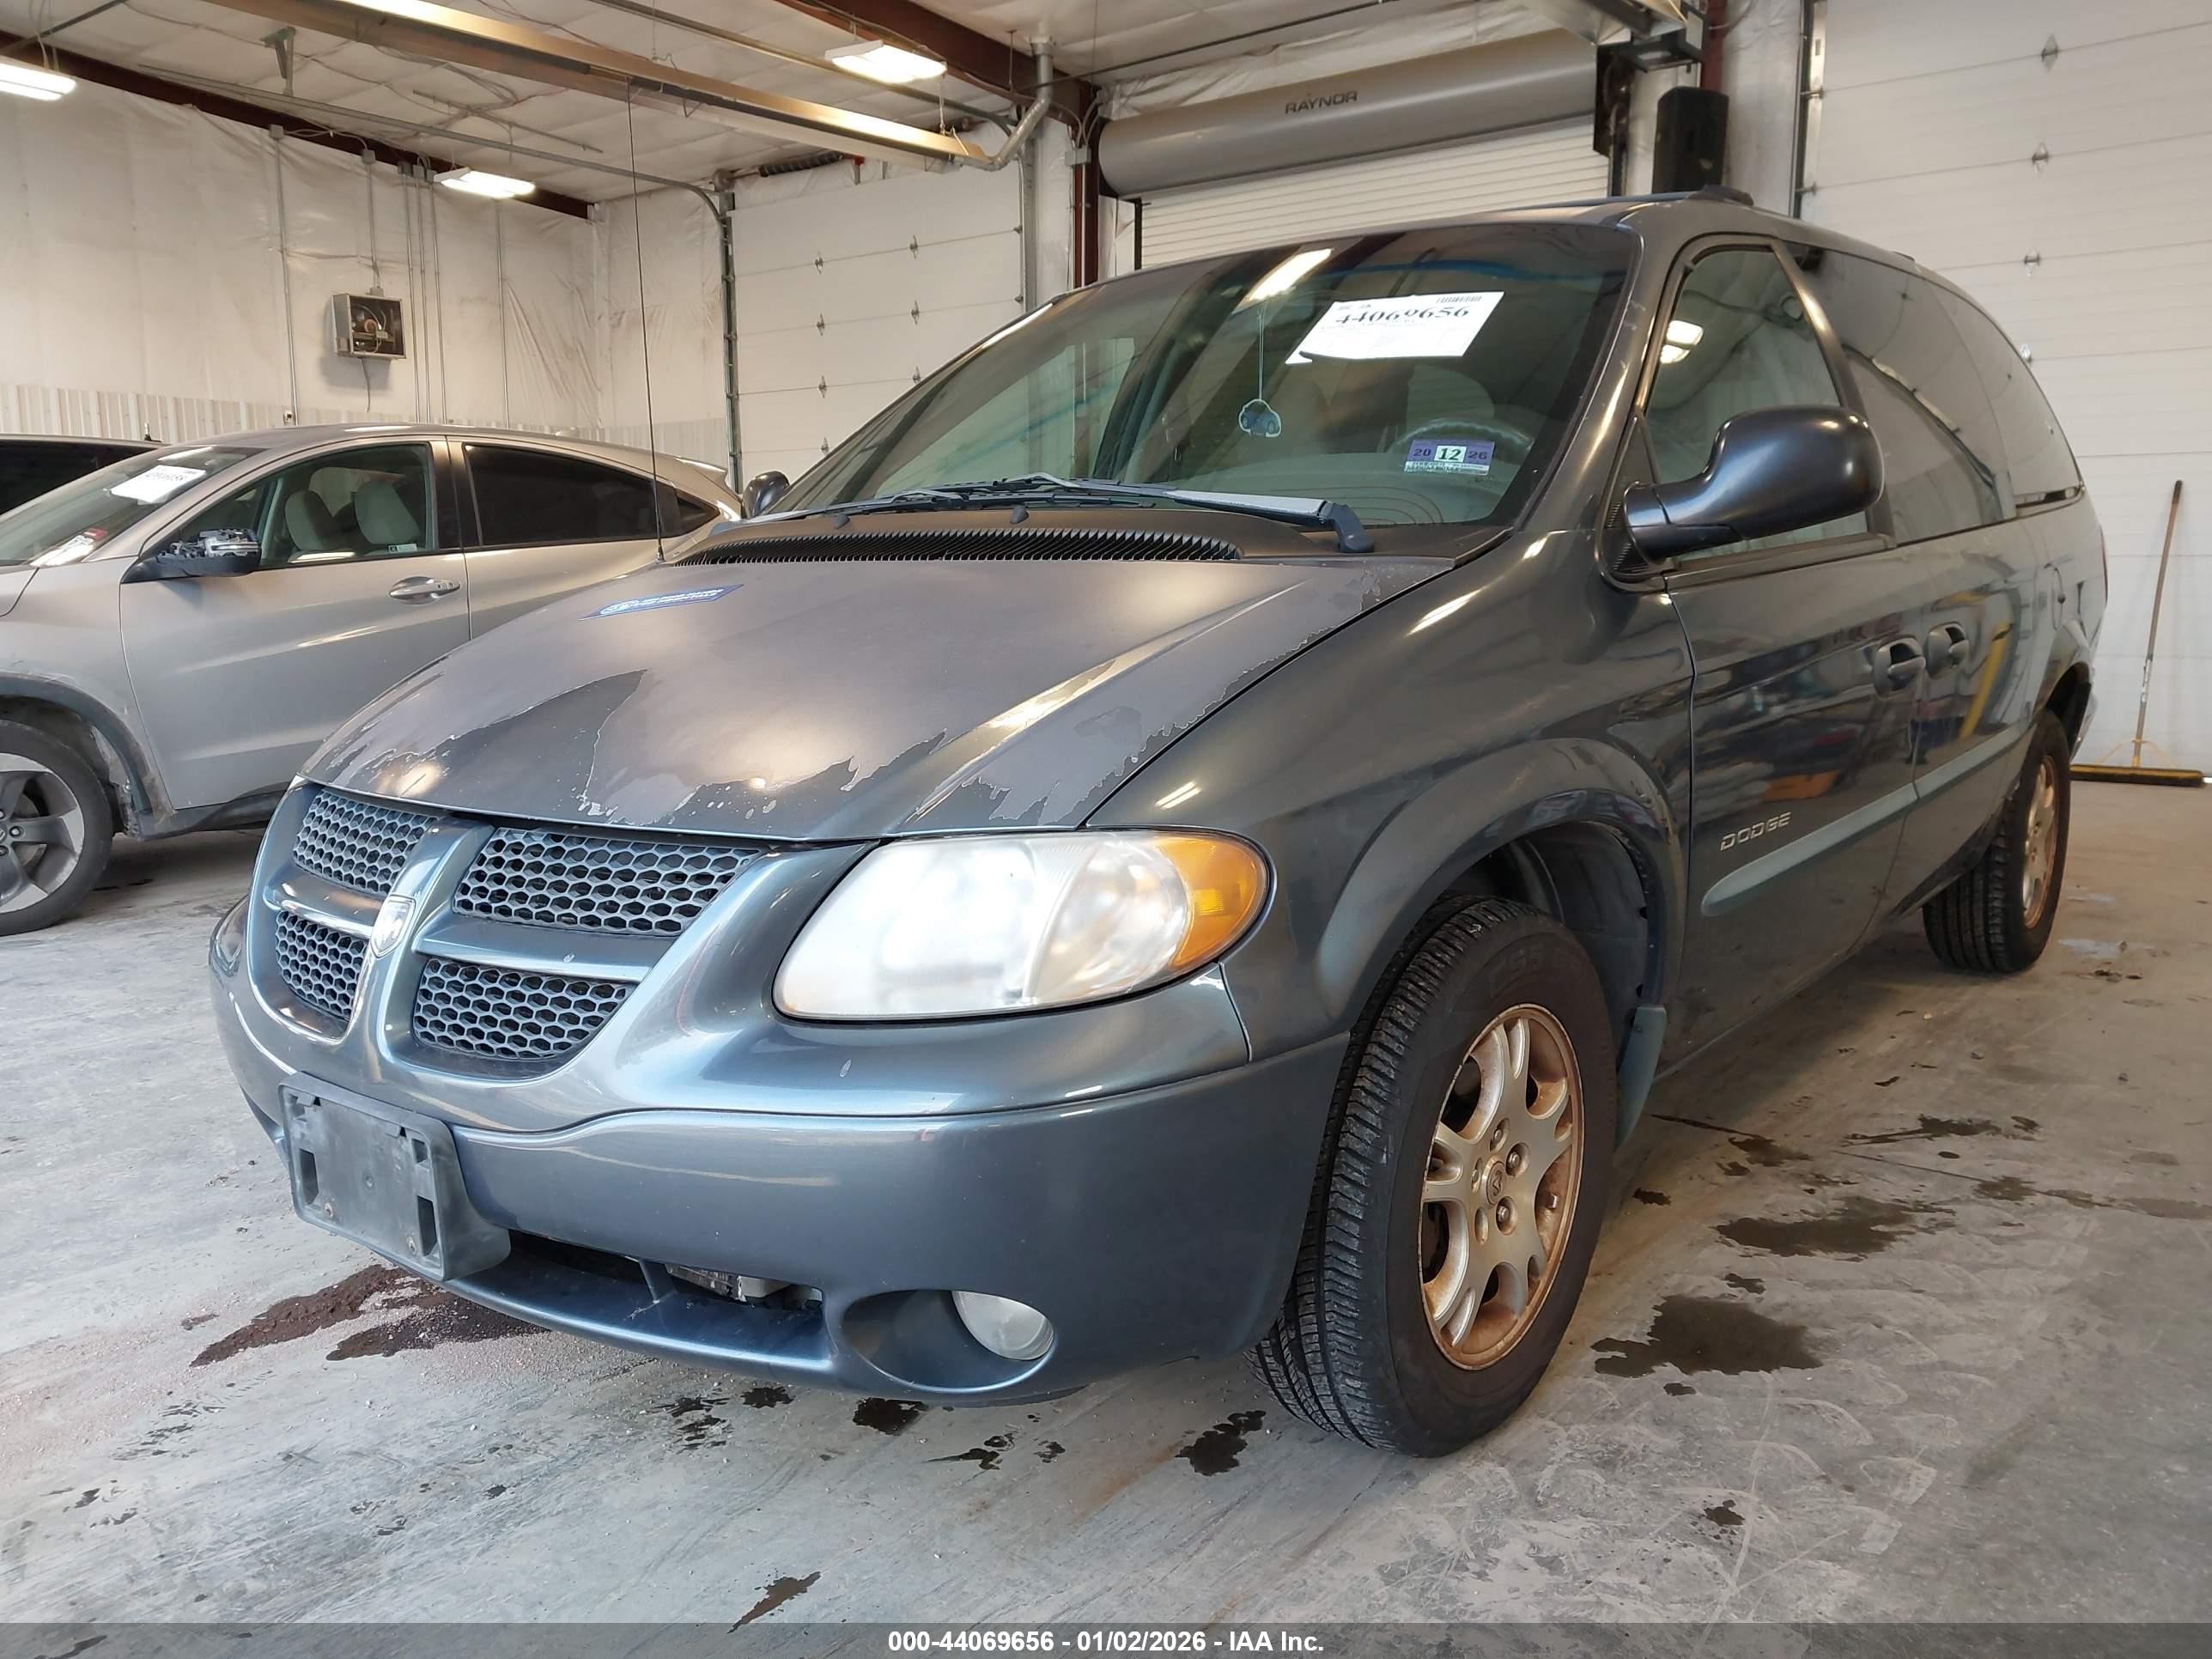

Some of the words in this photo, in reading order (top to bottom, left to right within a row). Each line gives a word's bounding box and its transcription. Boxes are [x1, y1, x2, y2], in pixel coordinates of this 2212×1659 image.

[1285, 90, 1358, 114] RAYNOR
[1413, 448, 1431, 457] 20
[1438, 447, 1462, 460] 12
[1468, 451, 1487, 459] 26
[1720, 811, 1792, 851] DODGE
